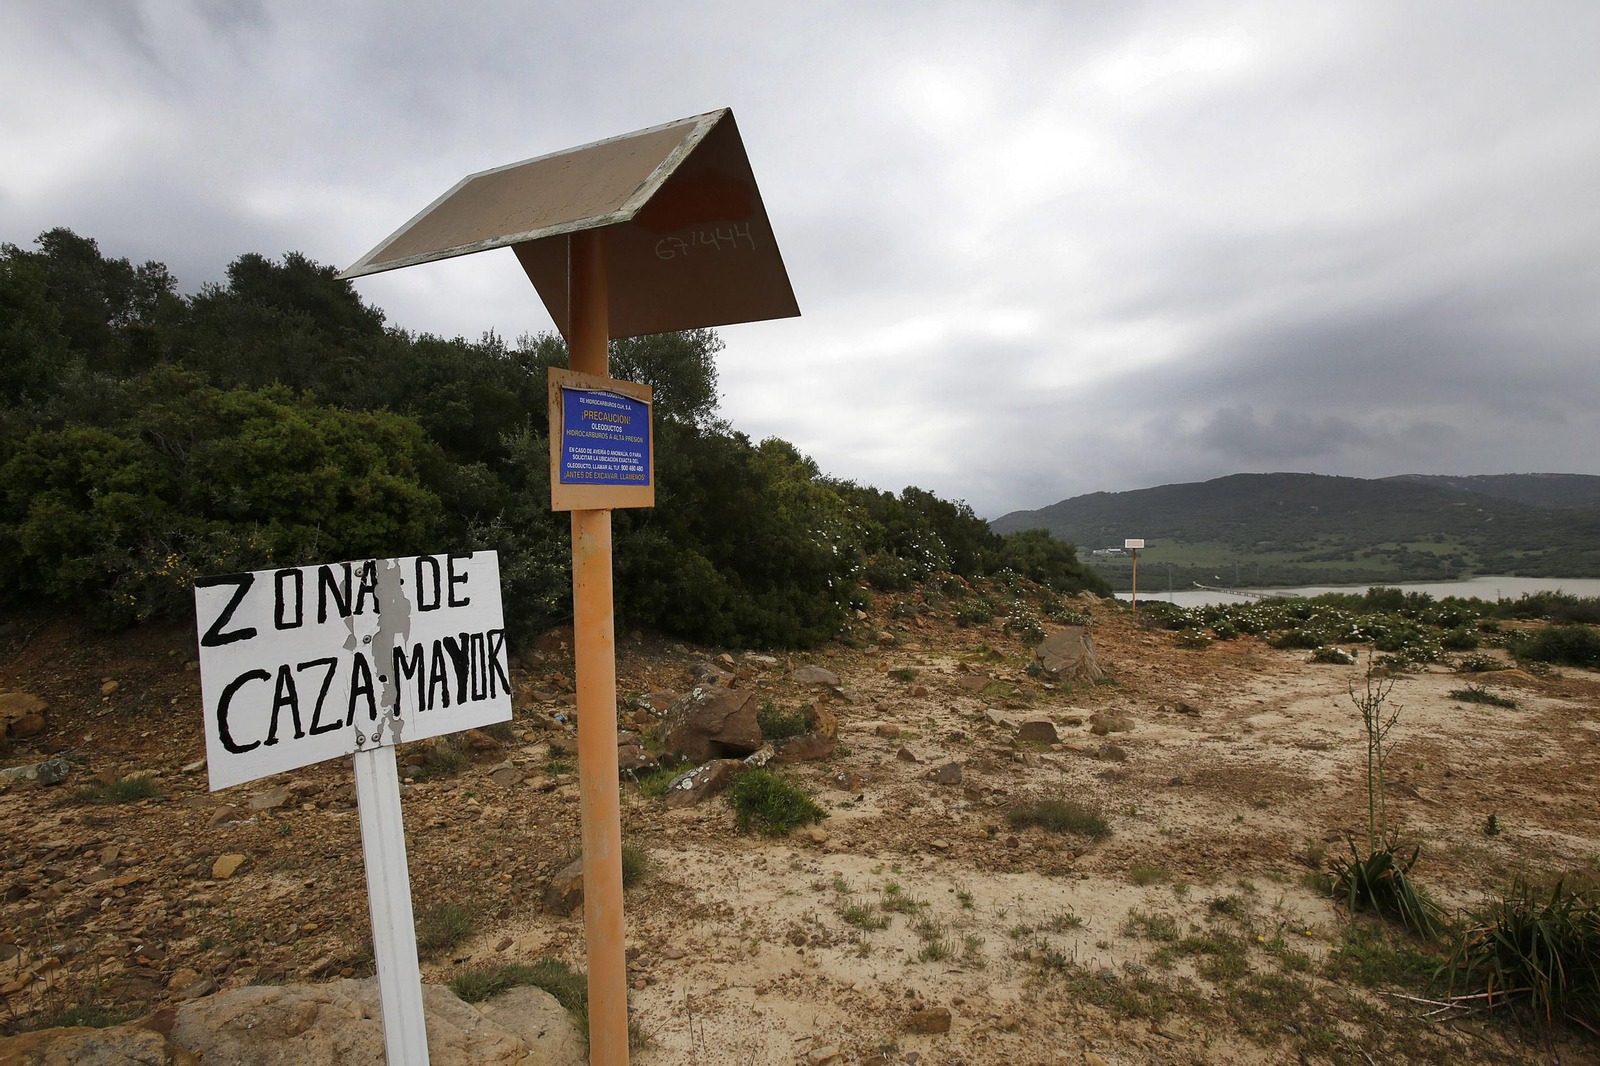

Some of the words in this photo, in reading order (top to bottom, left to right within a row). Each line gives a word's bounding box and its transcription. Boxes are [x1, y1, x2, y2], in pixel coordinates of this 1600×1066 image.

[586, 398, 616, 408] HIDROCARBUROS
[581, 410, 631, 424] ¡PRECAUCIÓN!
[591, 423, 622, 432] OLEODUCTOS
[566, 430, 608, 439] HIDROCARBUROS
[585, 471, 593, 479] DE
[194, 560, 381, 648] ZONA
[415, 552, 474, 612] DE
[216, 651, 377, 755] CAZA
[393, 629, 513, 718] MAYOR
